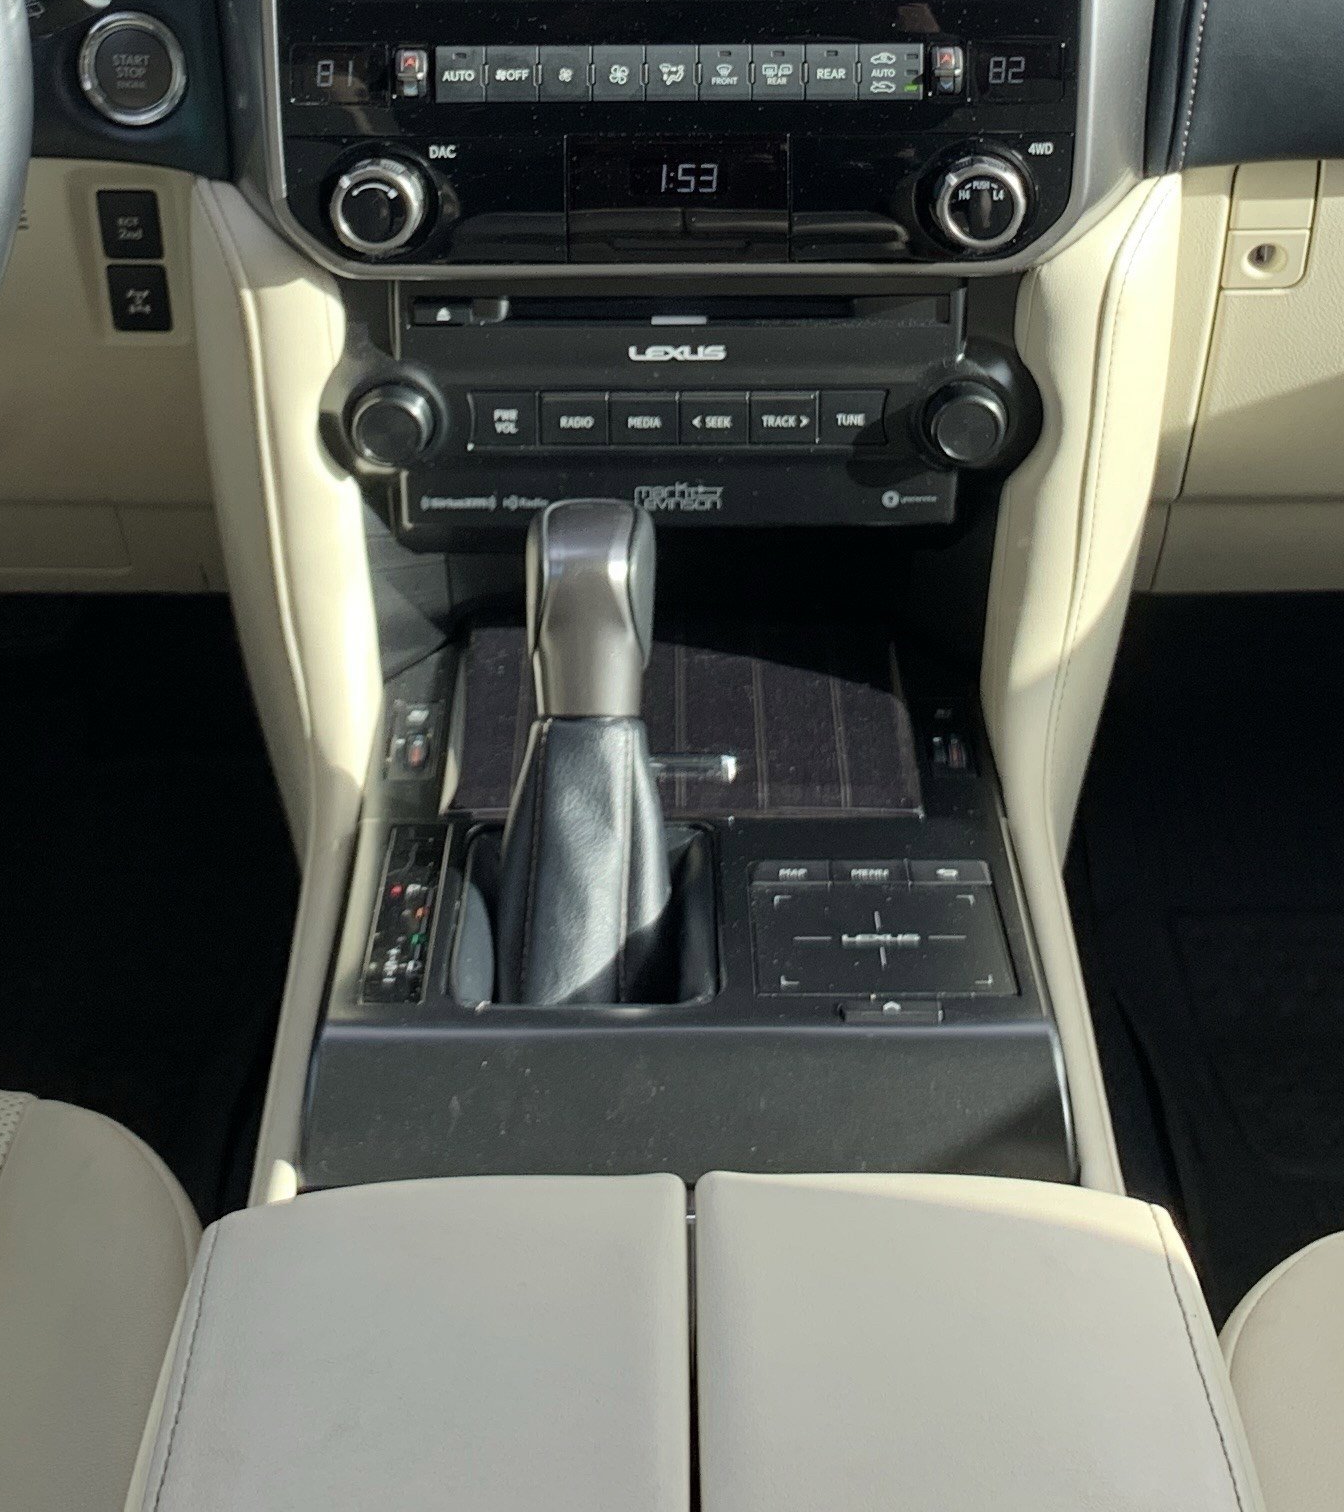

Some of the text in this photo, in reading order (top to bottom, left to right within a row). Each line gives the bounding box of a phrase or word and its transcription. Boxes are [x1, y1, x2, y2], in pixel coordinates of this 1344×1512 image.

[112, 54, 150, 66] START
[115, 66, 146, 79] STOP
[317, 59, 353, 87] 81
[442, 70, 475, 82] AUTO
[507, 69, 530, 81] OFF
[816, 68, 846, 80] REAR
[871, 68, 896, 78] AUTO
[989, 57, 1025, 83] 82
[711, 77, 738, 86] FRONT
[767, 77, 787, 86] REAR
[429, 145, 456, 159] DAC
[1028, 142, 1053, 155] 4WD
[661, 164, 718, 193] 1:53
[972, 179, 991, 190] PUSH
[958, 189, 970, 200] H4
[992, 189, 1004, 200] L4
[628, 345, 727, 361] LEXUS
[560, 416, 594, 429] RADIO
[628, 416, 662, 429] MEDIA
[705, 415, 732, 428] SEEK
[761, 415, 797, 428] TRACK
[836, 413, 866, 426] TUNE
